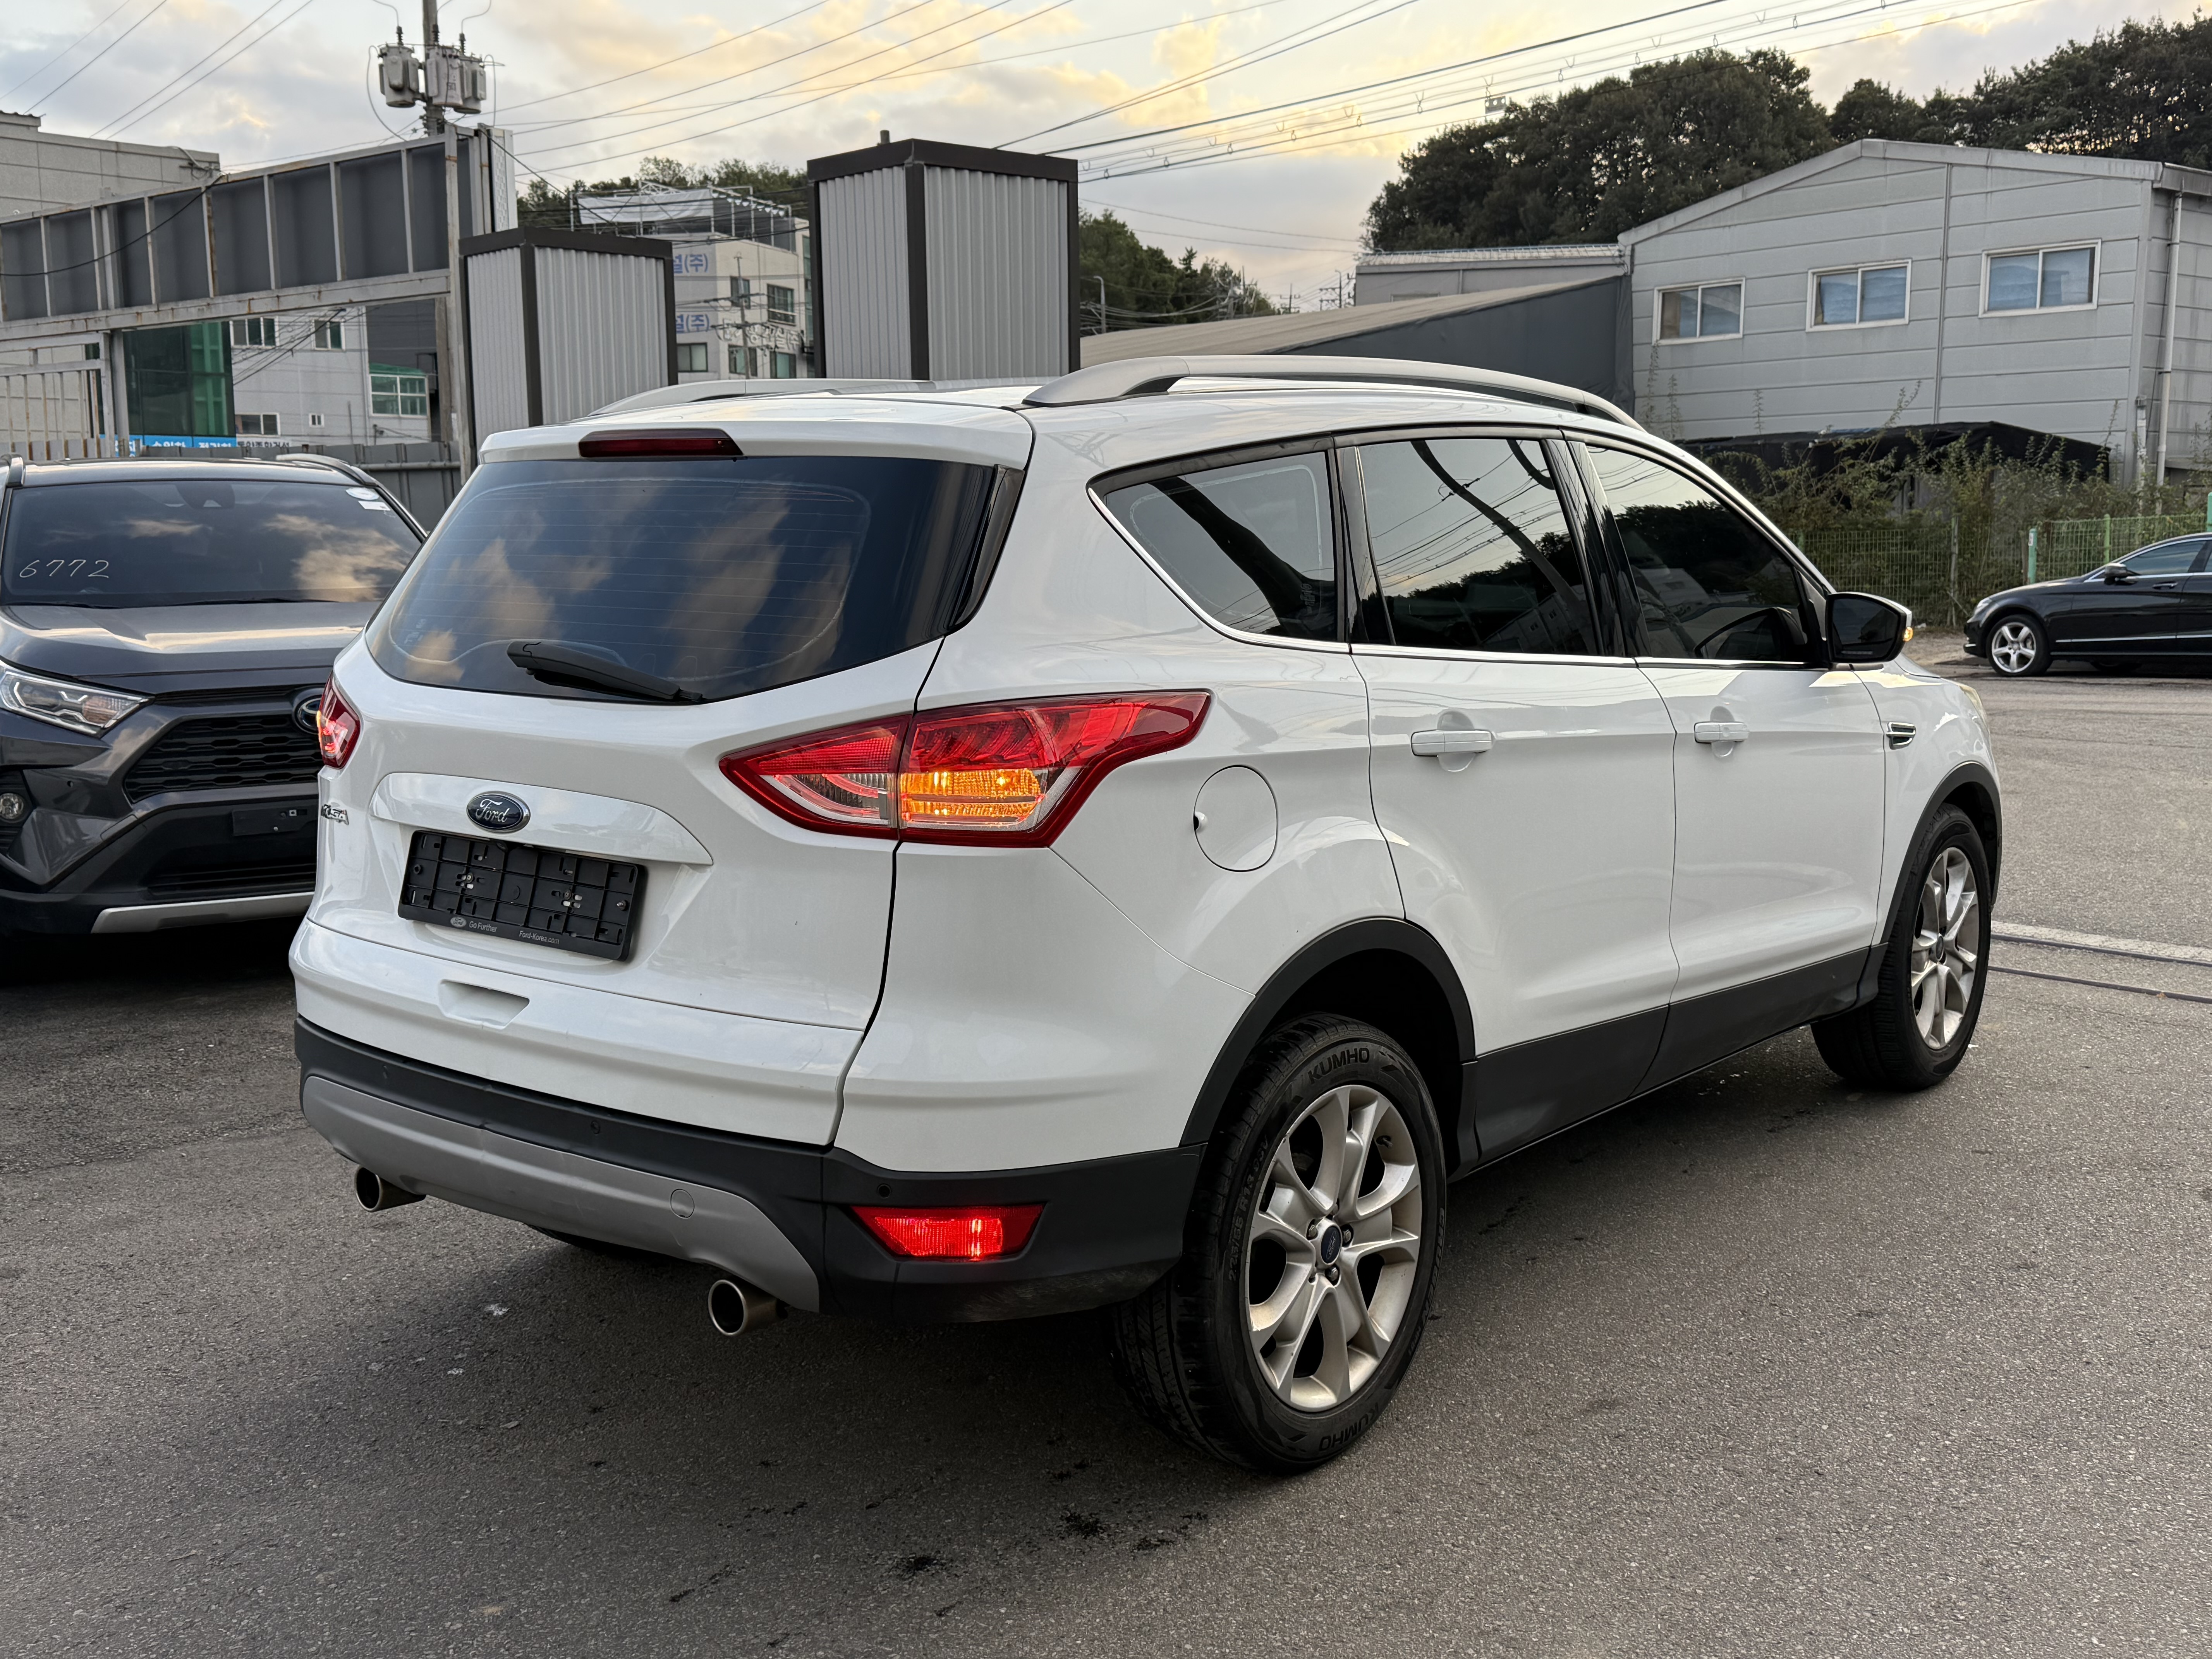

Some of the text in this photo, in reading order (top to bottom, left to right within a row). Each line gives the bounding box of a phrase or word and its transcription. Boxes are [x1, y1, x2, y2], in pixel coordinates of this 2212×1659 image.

[19, 560, 109, 578] 6772
[475, 799, 510, 823] Ford
[469, 921, 497, 933] Go Further
[519, 930, 560, 945] Ford-Korea.com
[1307, 1047, 1370, 1084] KUMHO
[1319, 1402, 1379, 1451] KUMHO
